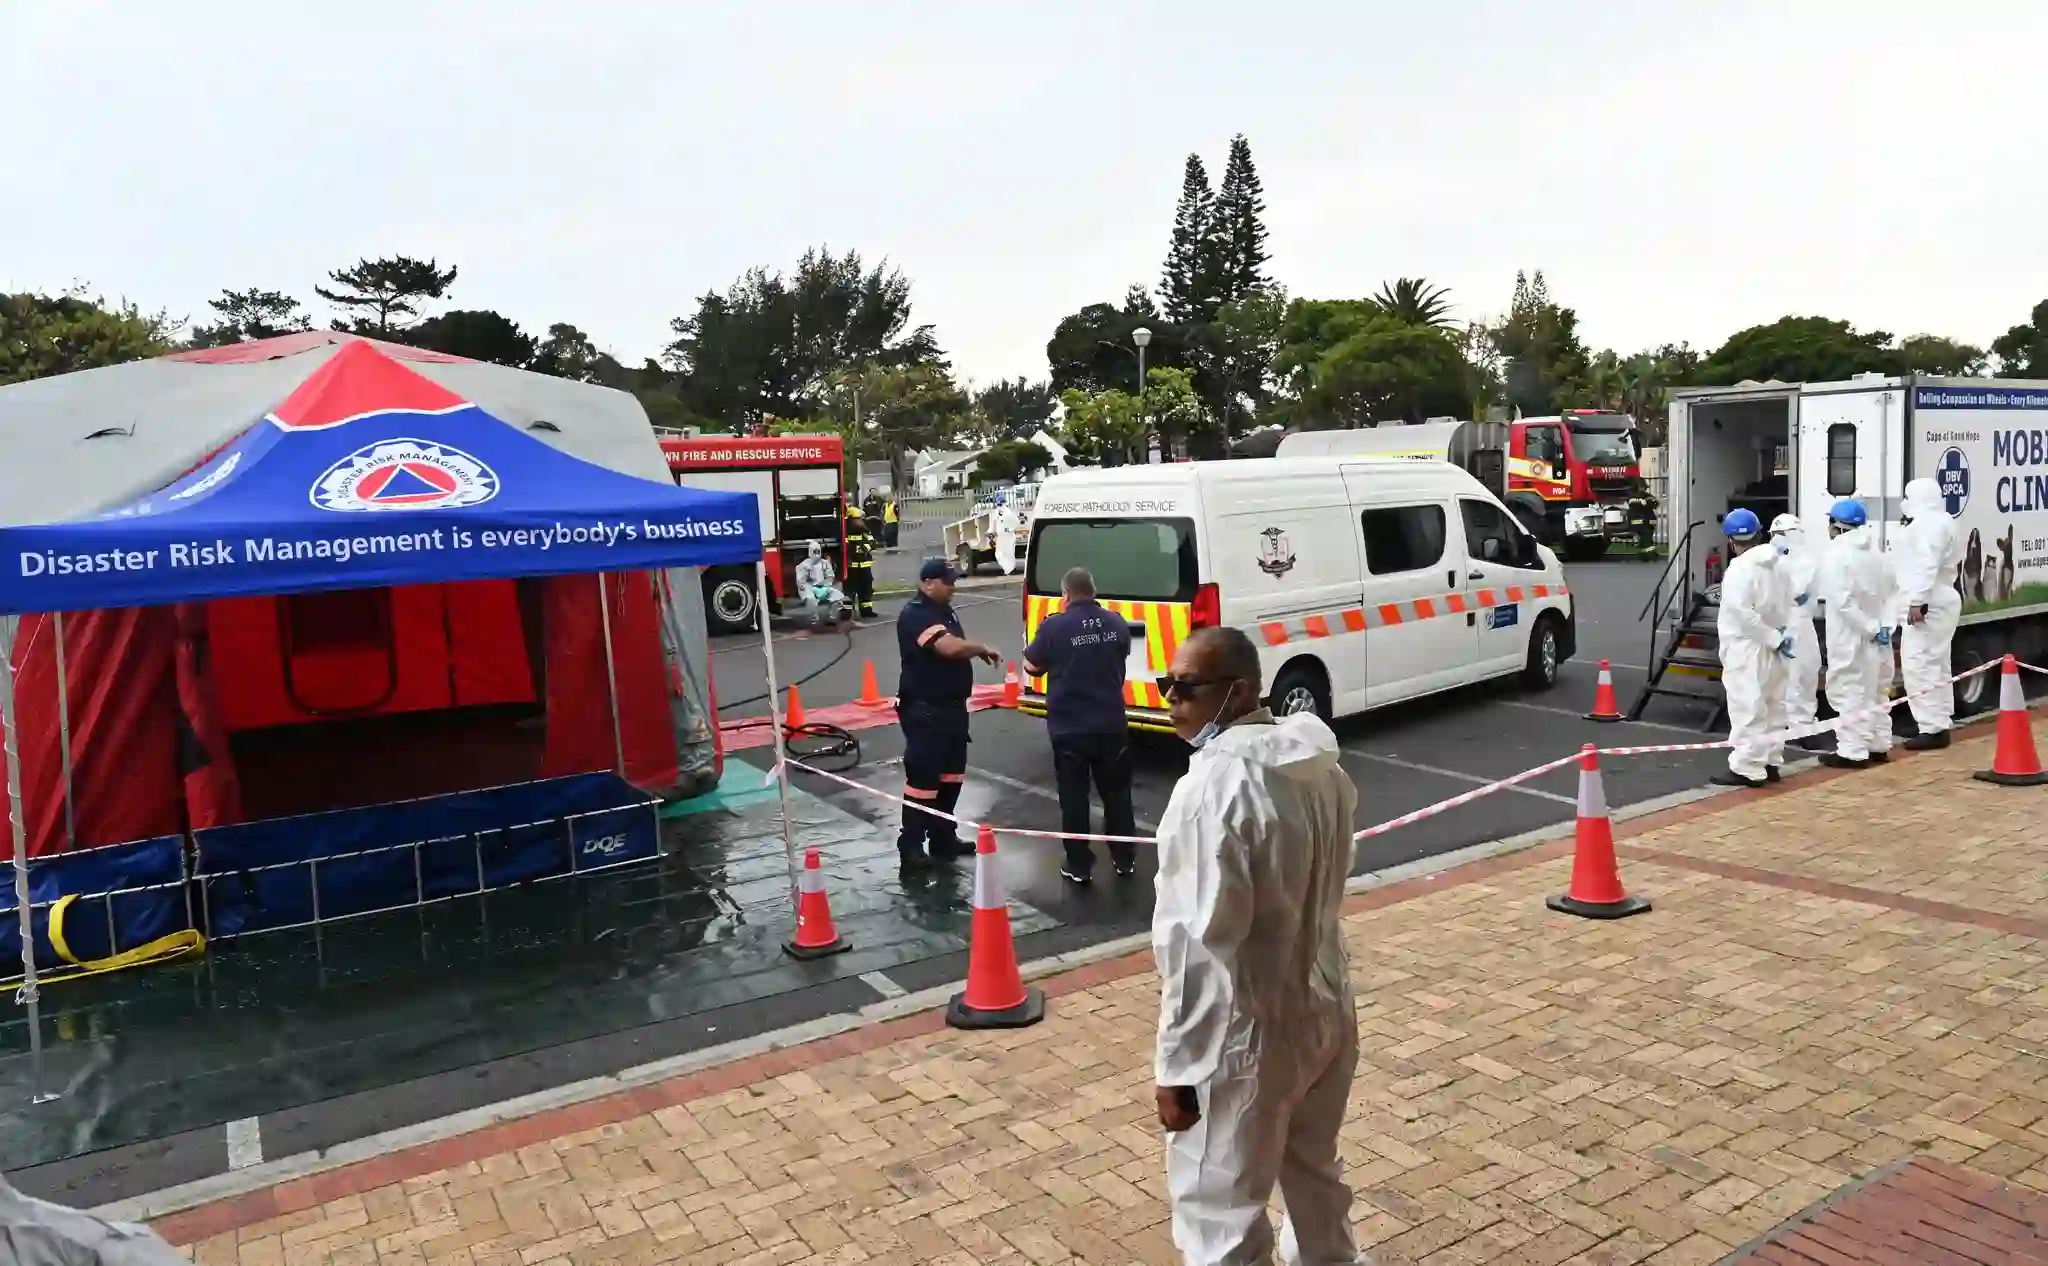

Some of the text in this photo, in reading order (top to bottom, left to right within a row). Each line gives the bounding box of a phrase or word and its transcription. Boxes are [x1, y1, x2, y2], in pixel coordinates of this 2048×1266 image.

[1919, 392, 1941, 406] Rolling
[1942, 393, 1978, 406] Compassion
[1979, 395, 1986, 405] on
[1987, 394, 2006, 405] Wheels
[2011, 395, 2026, 407] Every
[1926, 431, 1980, 443] Cape of Good Hope
[683, 451, 707, 462] FIRE
[710, 450, 733, 461] AND
[735, 449, 777, 460] RESCUE
[779, 448, 822, 459] SERVICE
[365, 454, 395, 468] RISK
[399, 452, 474, 486] MANAGEMENT
[1945, 471, 1961, 482] DBV
[1942, 483, 1964, 496] SPCA
[1996, 475, 2048, 513] CLIN
[1044, 500, 1176, 513] FORENSIC PATHOLOGY SERVICE
[20, 511, 744, 577] Disaster Risk Management is everybody's business
[1071, 633, 1100, 647] WESTERN
[583, 833, 628, 853] DQE
